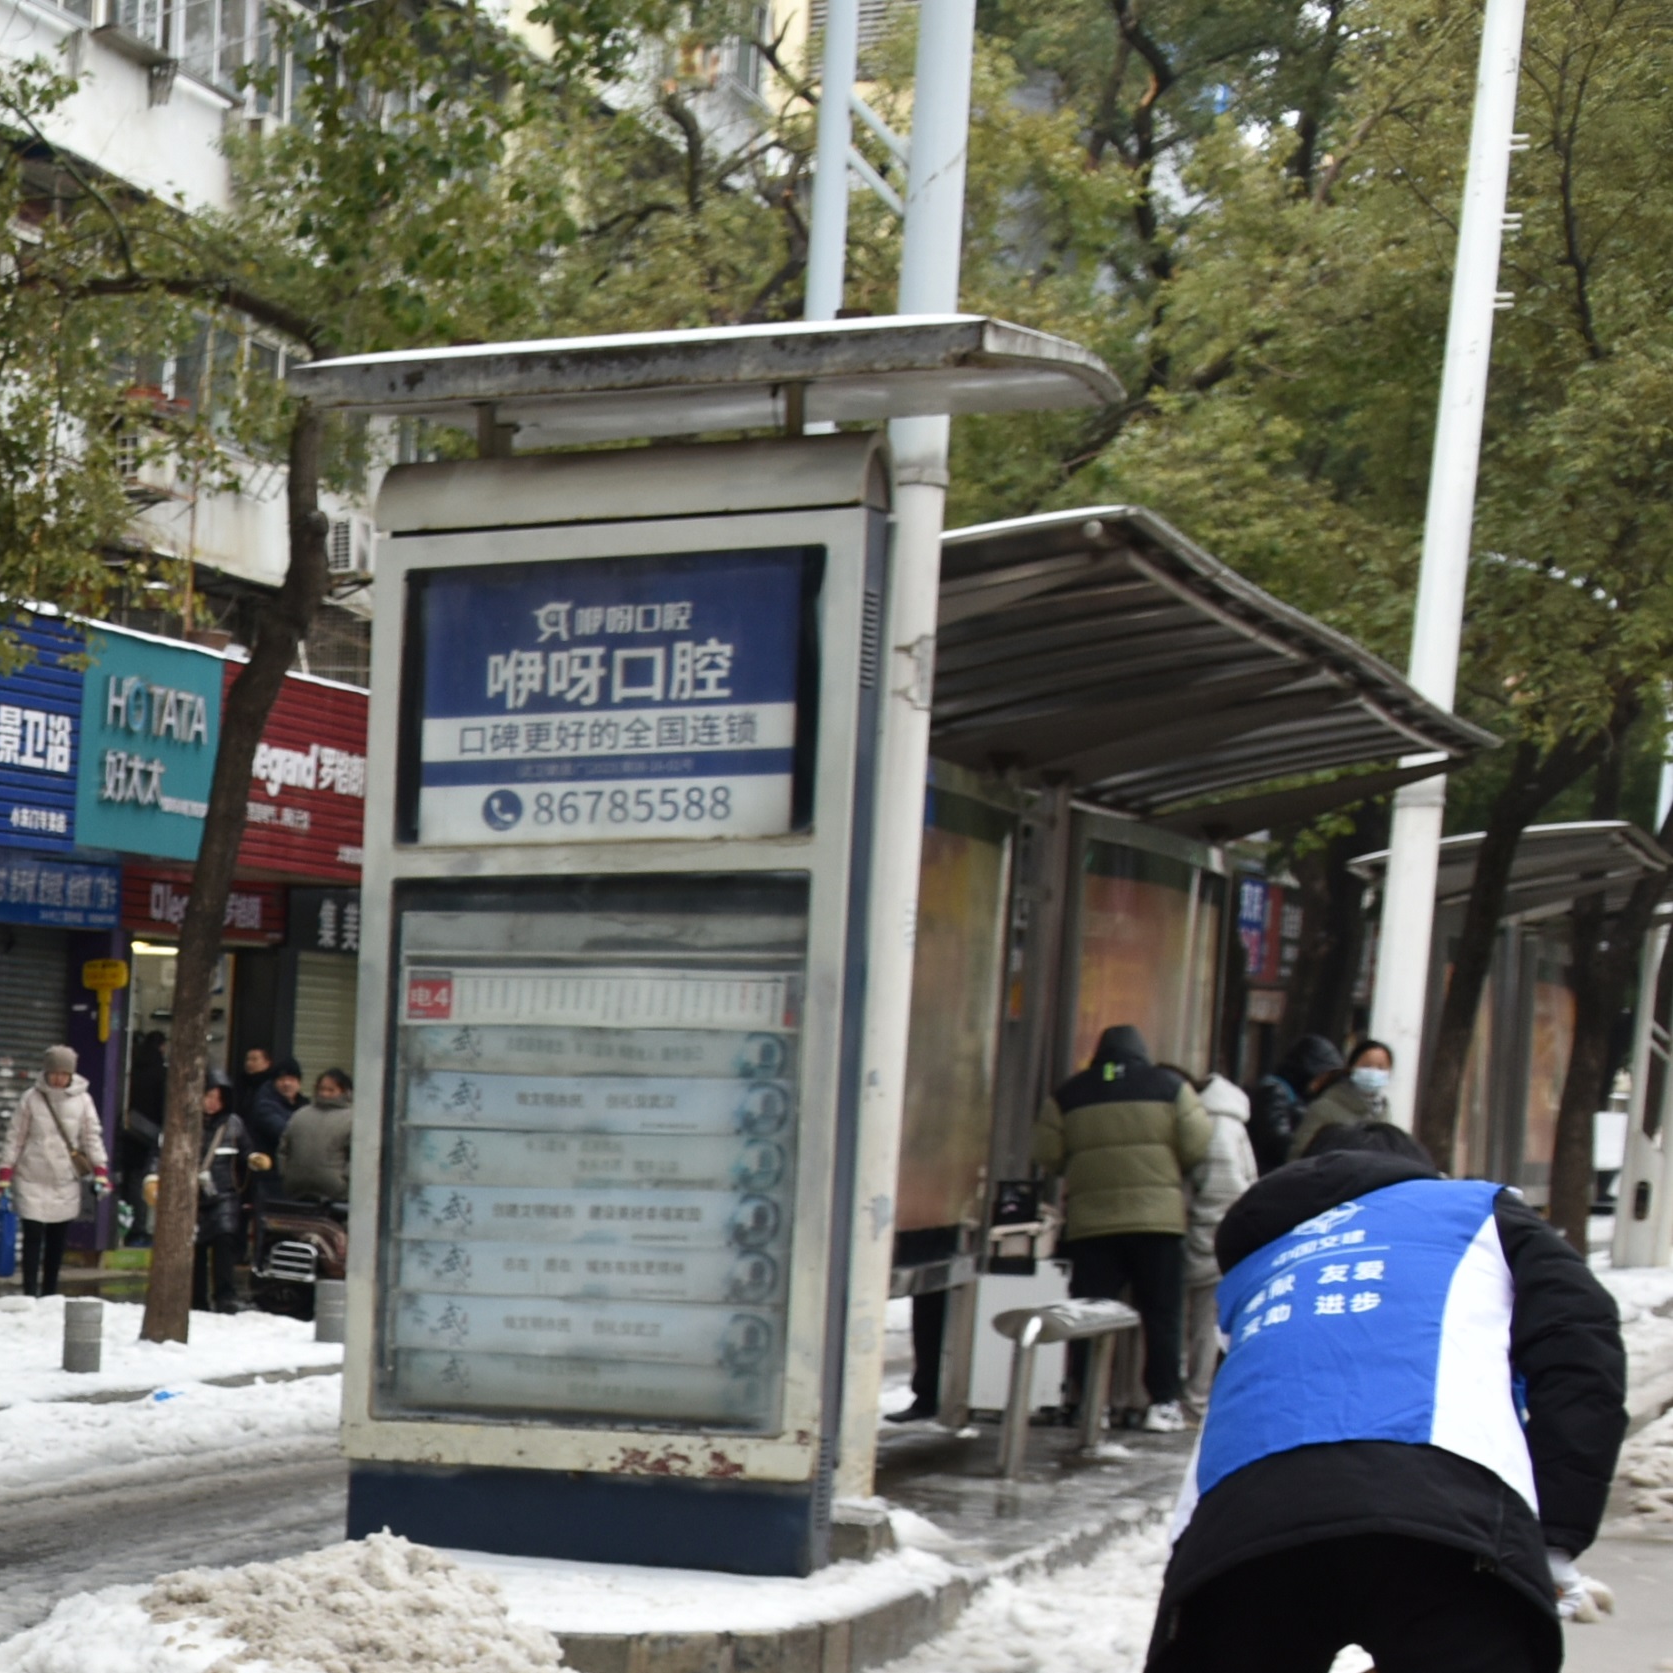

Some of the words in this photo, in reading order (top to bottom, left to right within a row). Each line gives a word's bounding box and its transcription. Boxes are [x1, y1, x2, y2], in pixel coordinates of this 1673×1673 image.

[487, 638, 733, 709] 咿呀口腔
[106, 675, 208, 745] HOTATA
[458, 711, 759, 756] 口碑更好的全国连锁
[102, 749, 166, 805] 好太太
[533, 786, 732, 826] 86785588
[1316, 1259, 1385, 1285] 友爱
[1313, 1290, 1382, 1316] 进步
